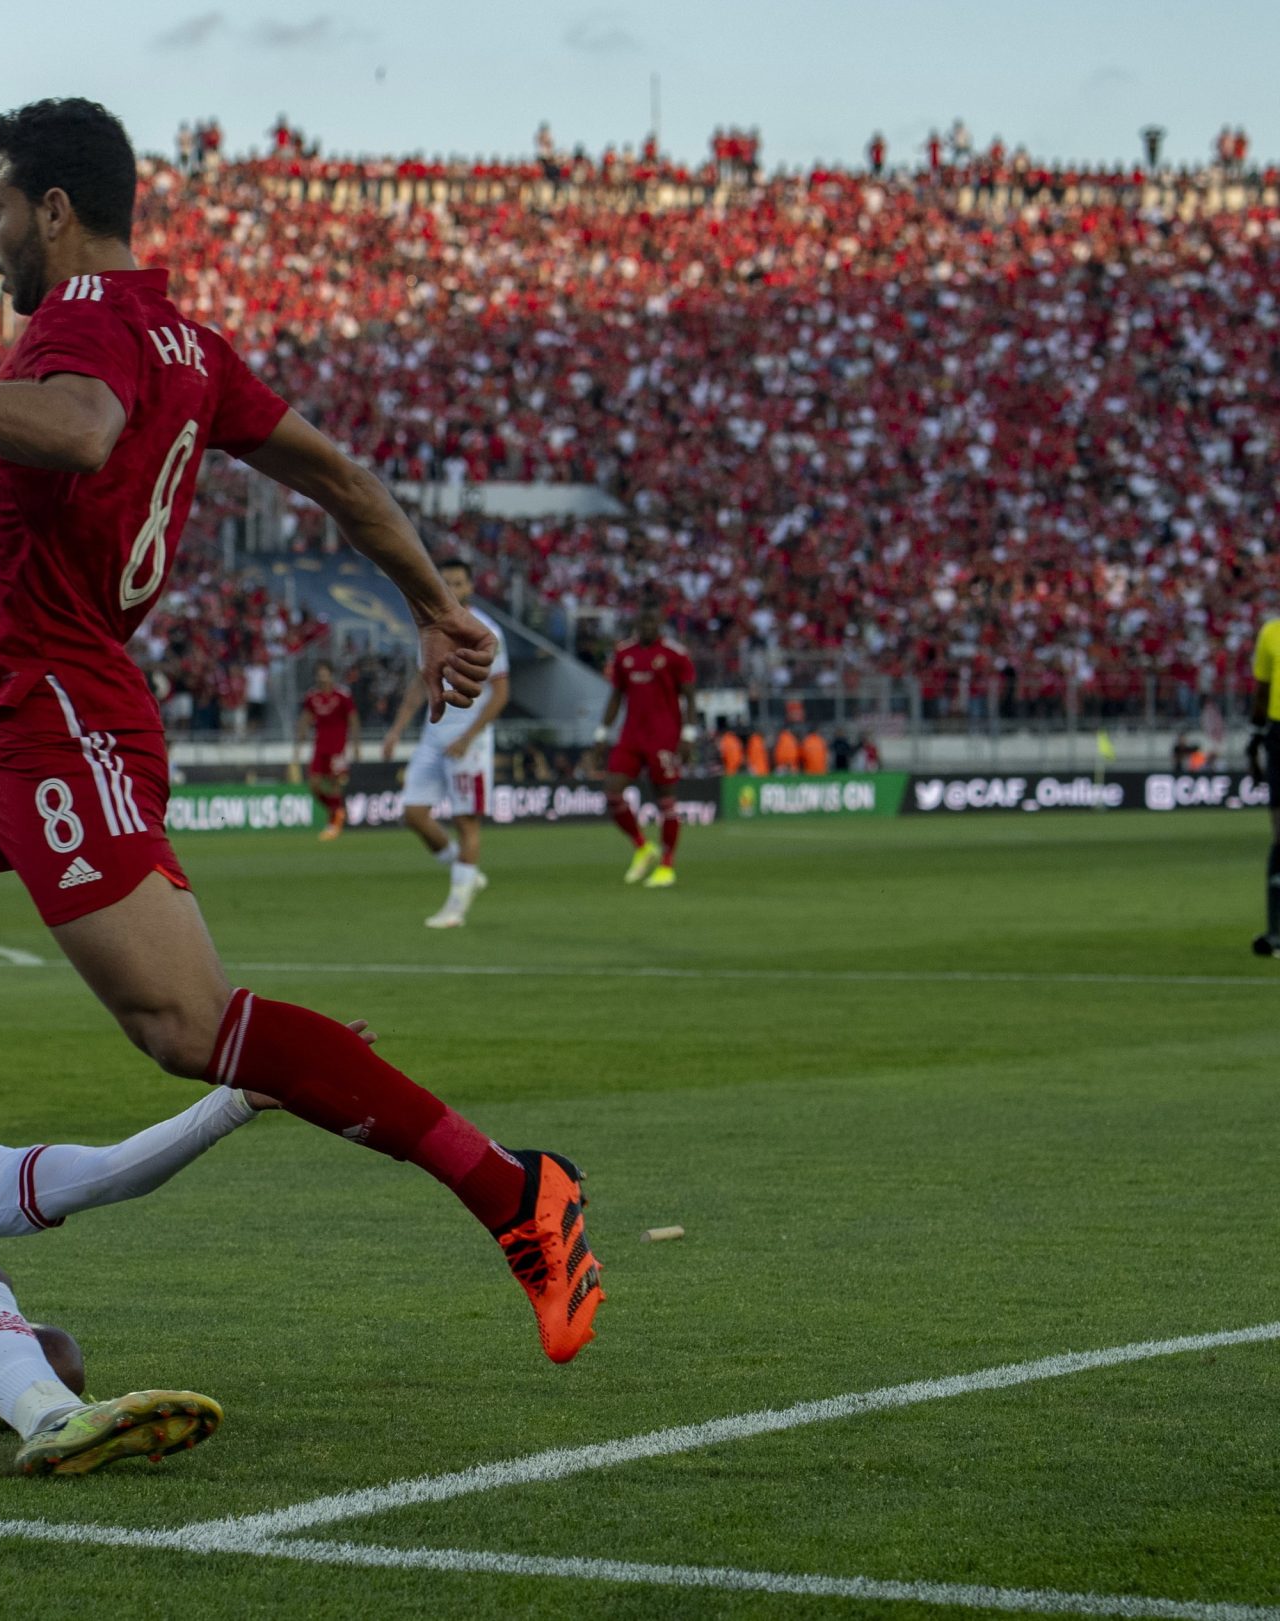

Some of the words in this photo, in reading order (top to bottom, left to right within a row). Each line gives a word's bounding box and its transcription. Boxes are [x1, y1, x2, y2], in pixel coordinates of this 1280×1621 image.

[119, 418, 199, 611] 8
[35, 777, 85, 854] 8
[164, 796, 246, 831] OLLOW
[248, 794, 278, 829] US
[280, 793, 313, 828] ON
[760, 783, 818, 814] FOLLOW
[843, 780, 875, 812] ON
